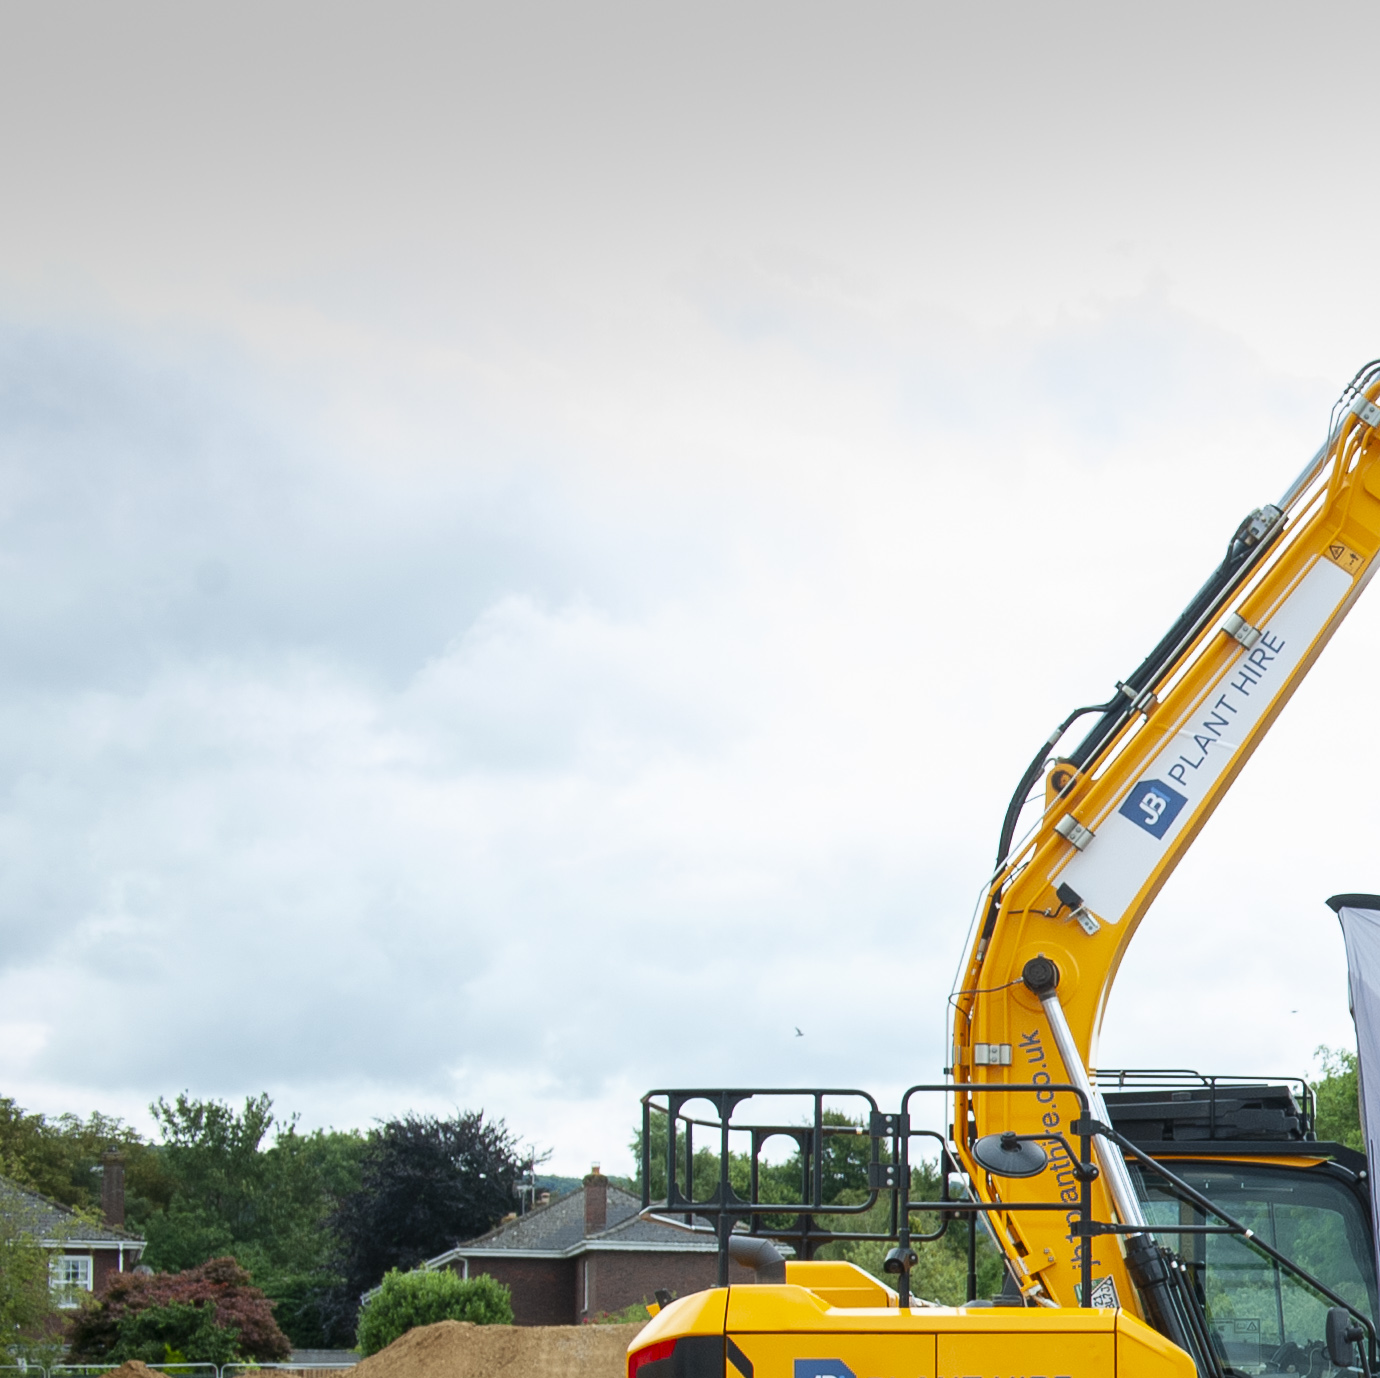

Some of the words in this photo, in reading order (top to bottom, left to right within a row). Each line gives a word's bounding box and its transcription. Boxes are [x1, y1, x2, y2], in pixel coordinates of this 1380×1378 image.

[1138, 786, 1171, 826] JB1
[1167, 694, 1237, 786] PLANT
[1230, 630, 1285, 696] HIRE
